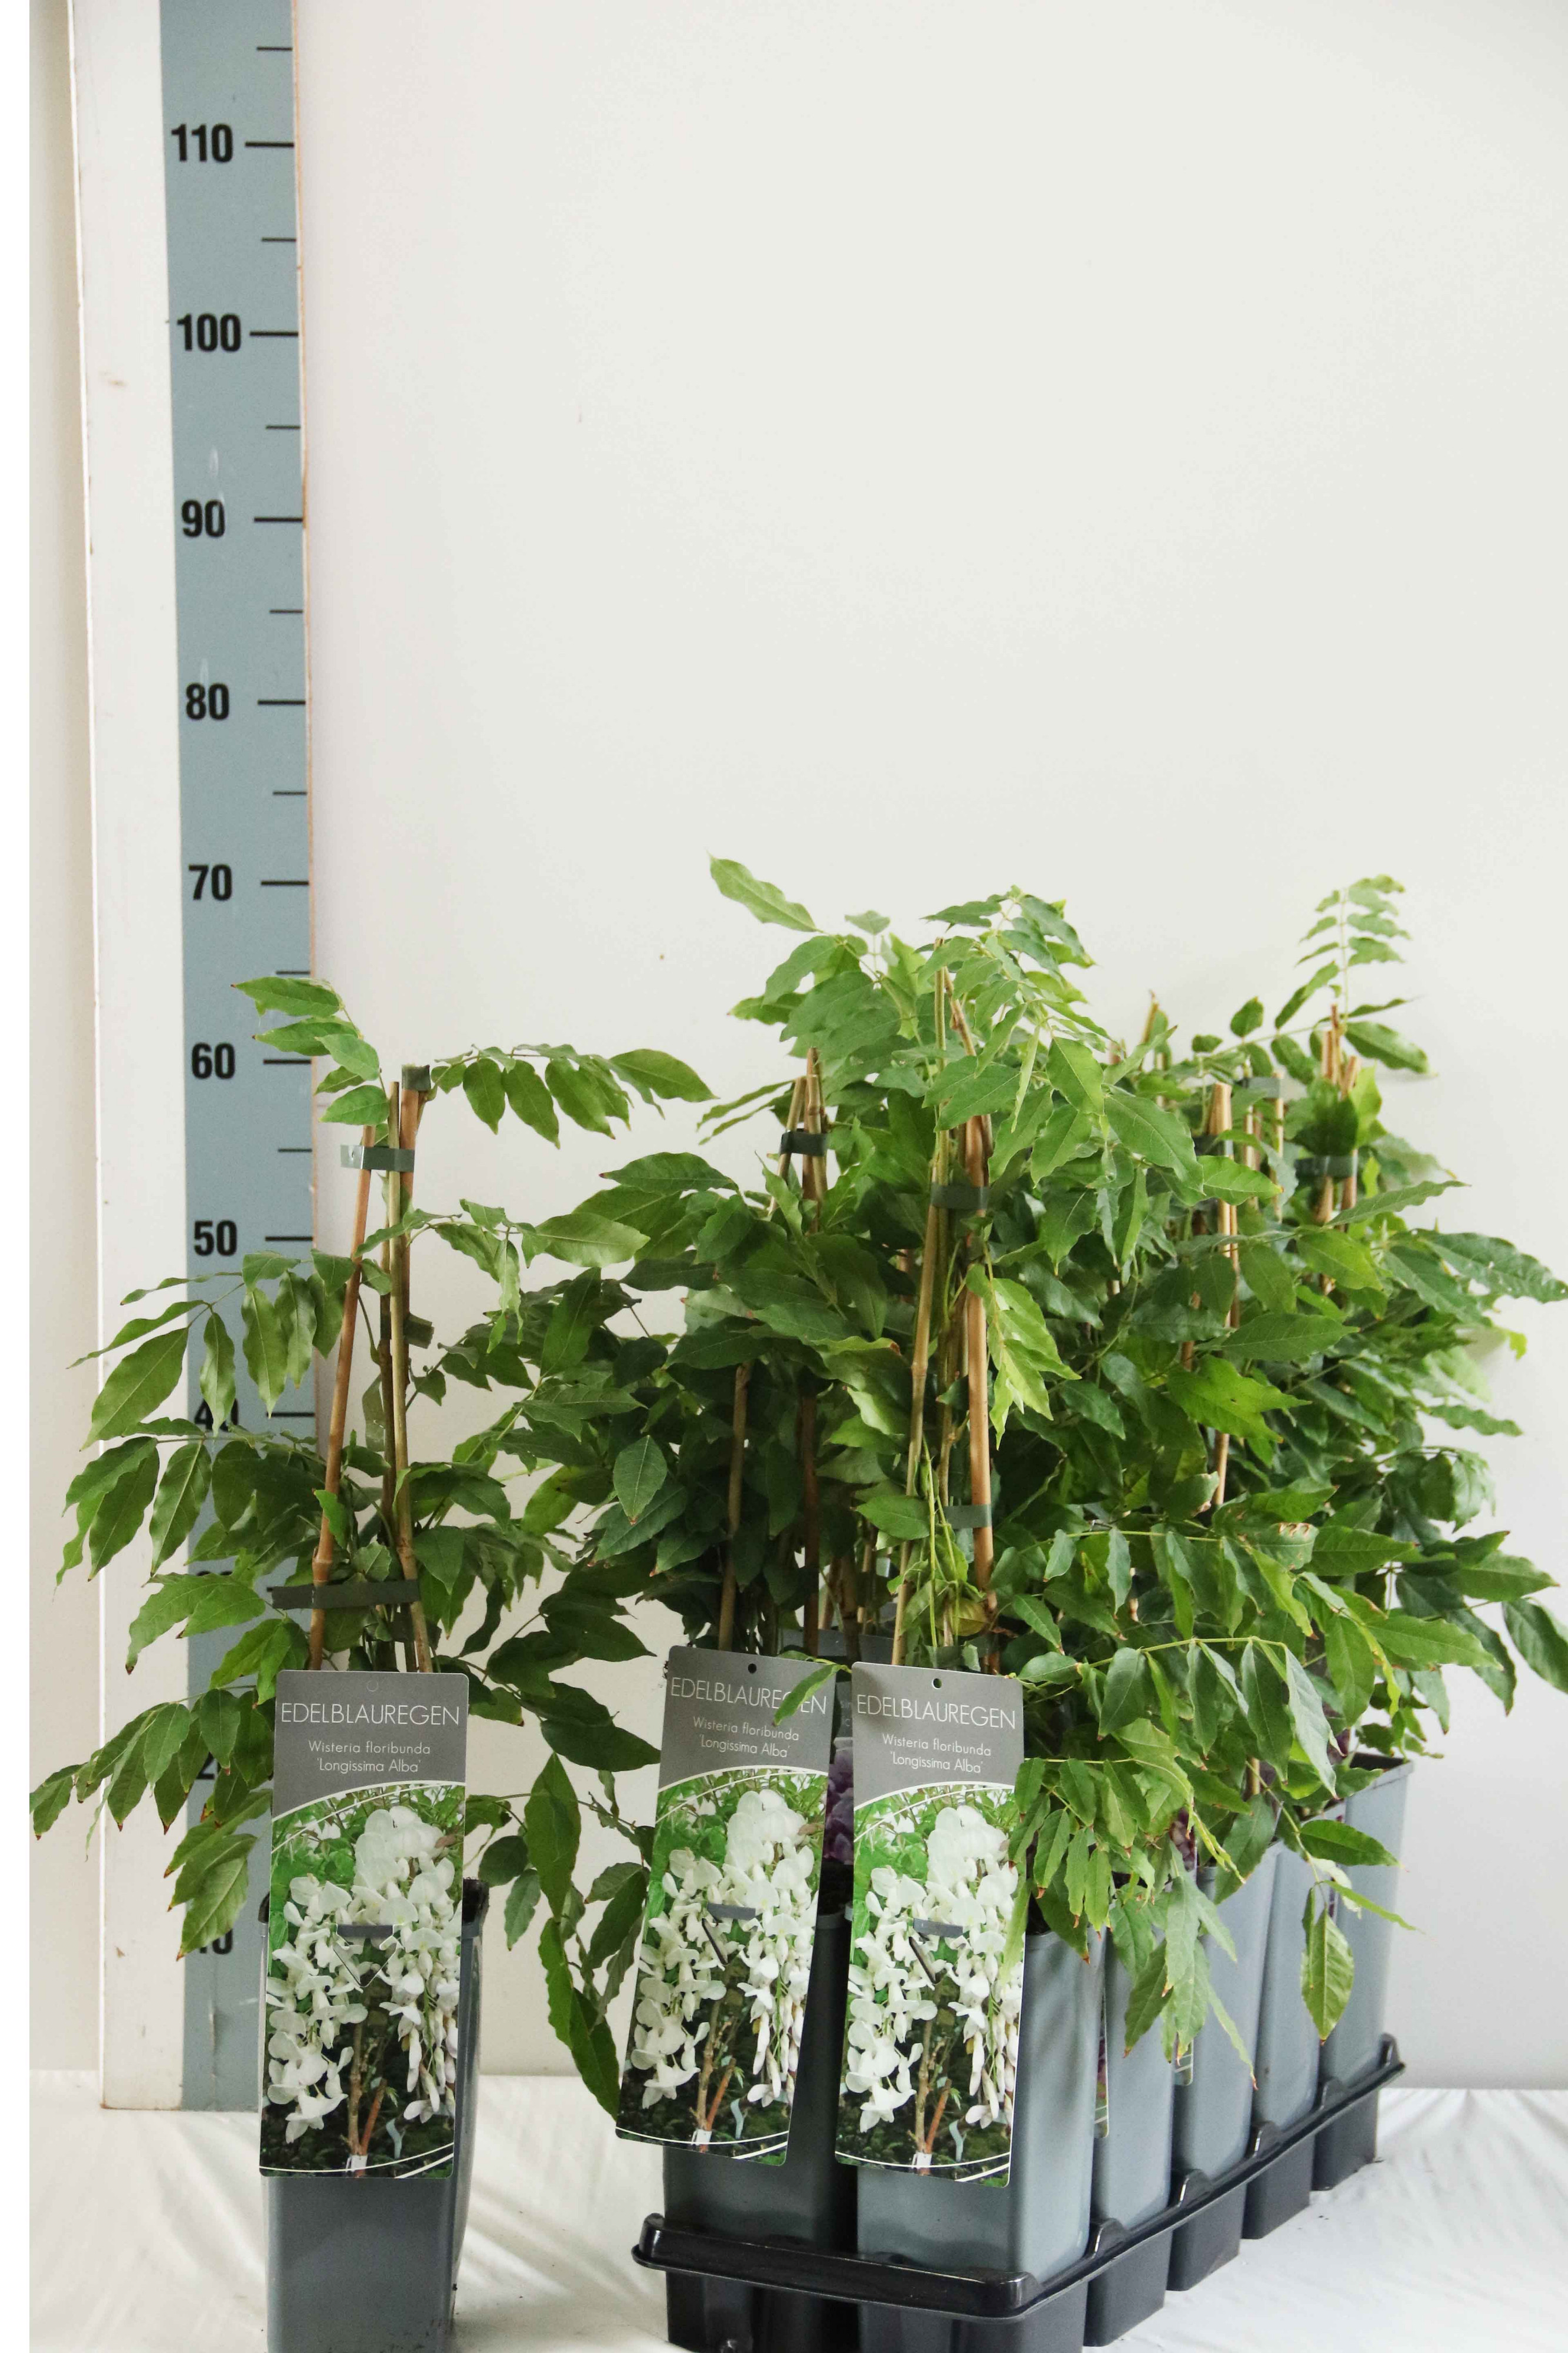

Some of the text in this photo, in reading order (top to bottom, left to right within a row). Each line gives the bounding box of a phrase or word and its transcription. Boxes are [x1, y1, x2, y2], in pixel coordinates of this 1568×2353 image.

[171, 124, 233, 163] 110
[176, 313, 241, 352] 100
[181, 499, 226, 538] 90
[185, 682, 229, 721] 80
[188, 864, 232, 902] 70
[191, 1042, 236, 1080] 60
[194, 1220, 238, 1257] 50
[281, 1702, 459, 1725] EDELBLAUREGEN
[693, 1717, 799, 1741] Wisteria floribunda
[858, 1694, 1016, 1729] EDELBLAUREGEN
[308, 1739, 431, 1755] Wisteria floribunda
[883, 1734, 992, 1757] Wisteria floribunda
